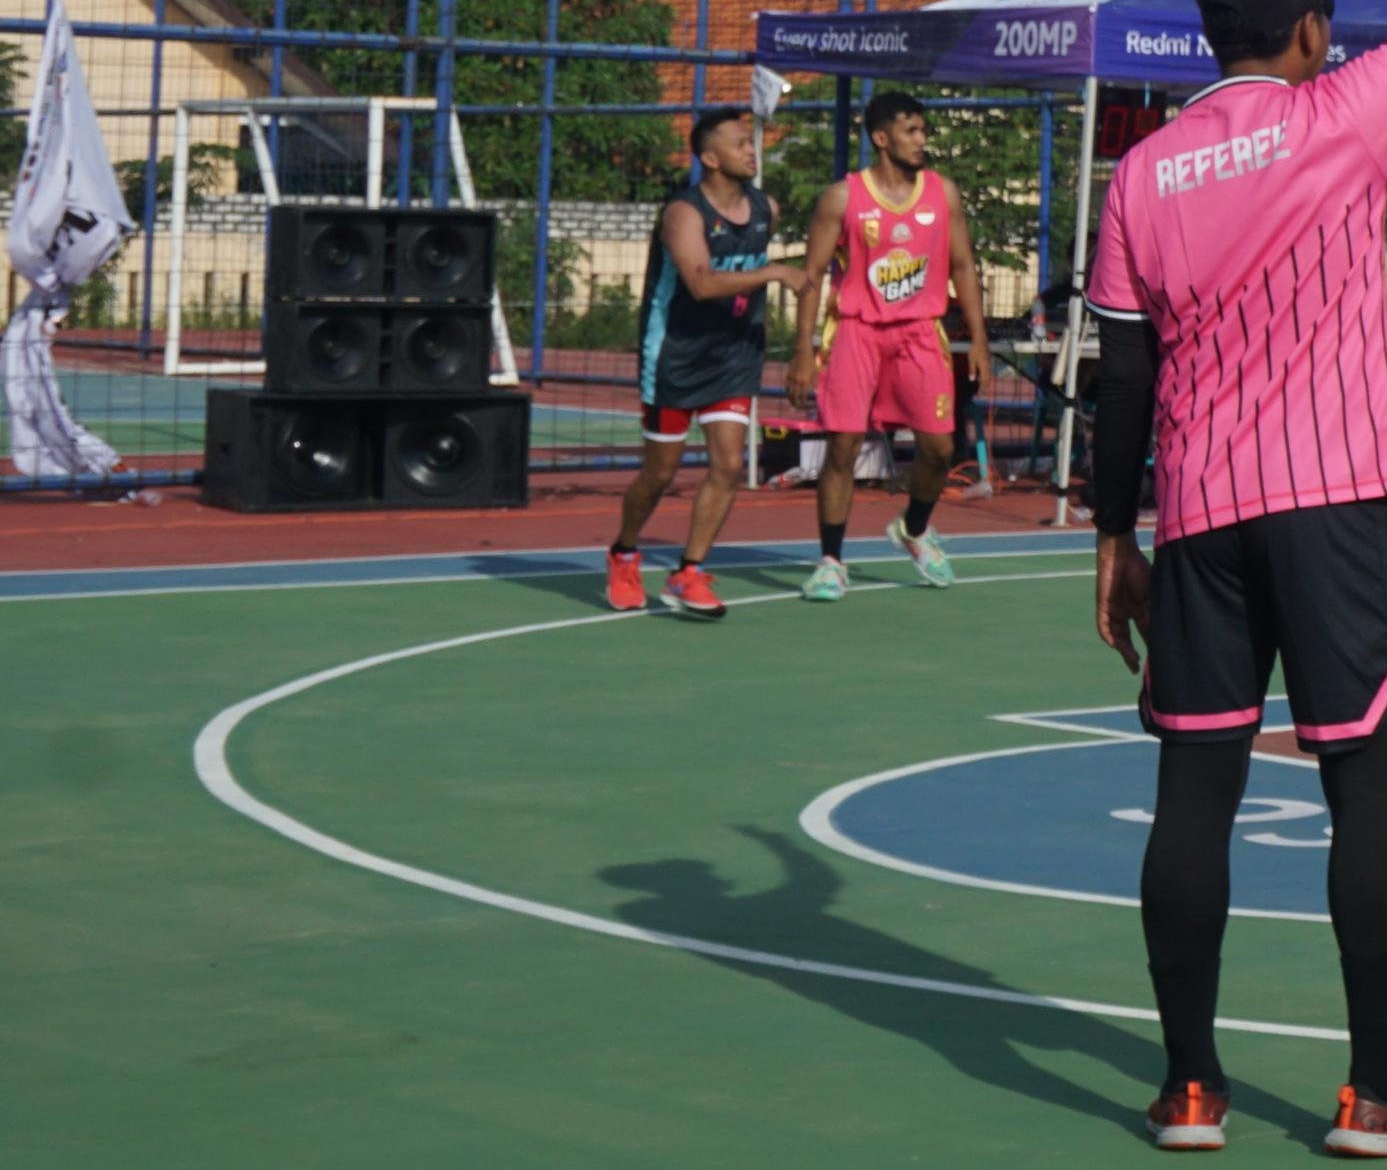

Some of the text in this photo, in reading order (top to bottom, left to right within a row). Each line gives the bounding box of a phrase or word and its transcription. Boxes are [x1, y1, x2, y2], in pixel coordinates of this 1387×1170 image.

[818, 27, 857, 52] shot
[859, 26, 909, 52] iconic
[993, 20, 1078, 57] 200MP
[1125, 30, 1191, 56] Redmi
[1155, 120, 1291, 199] REFEREE
